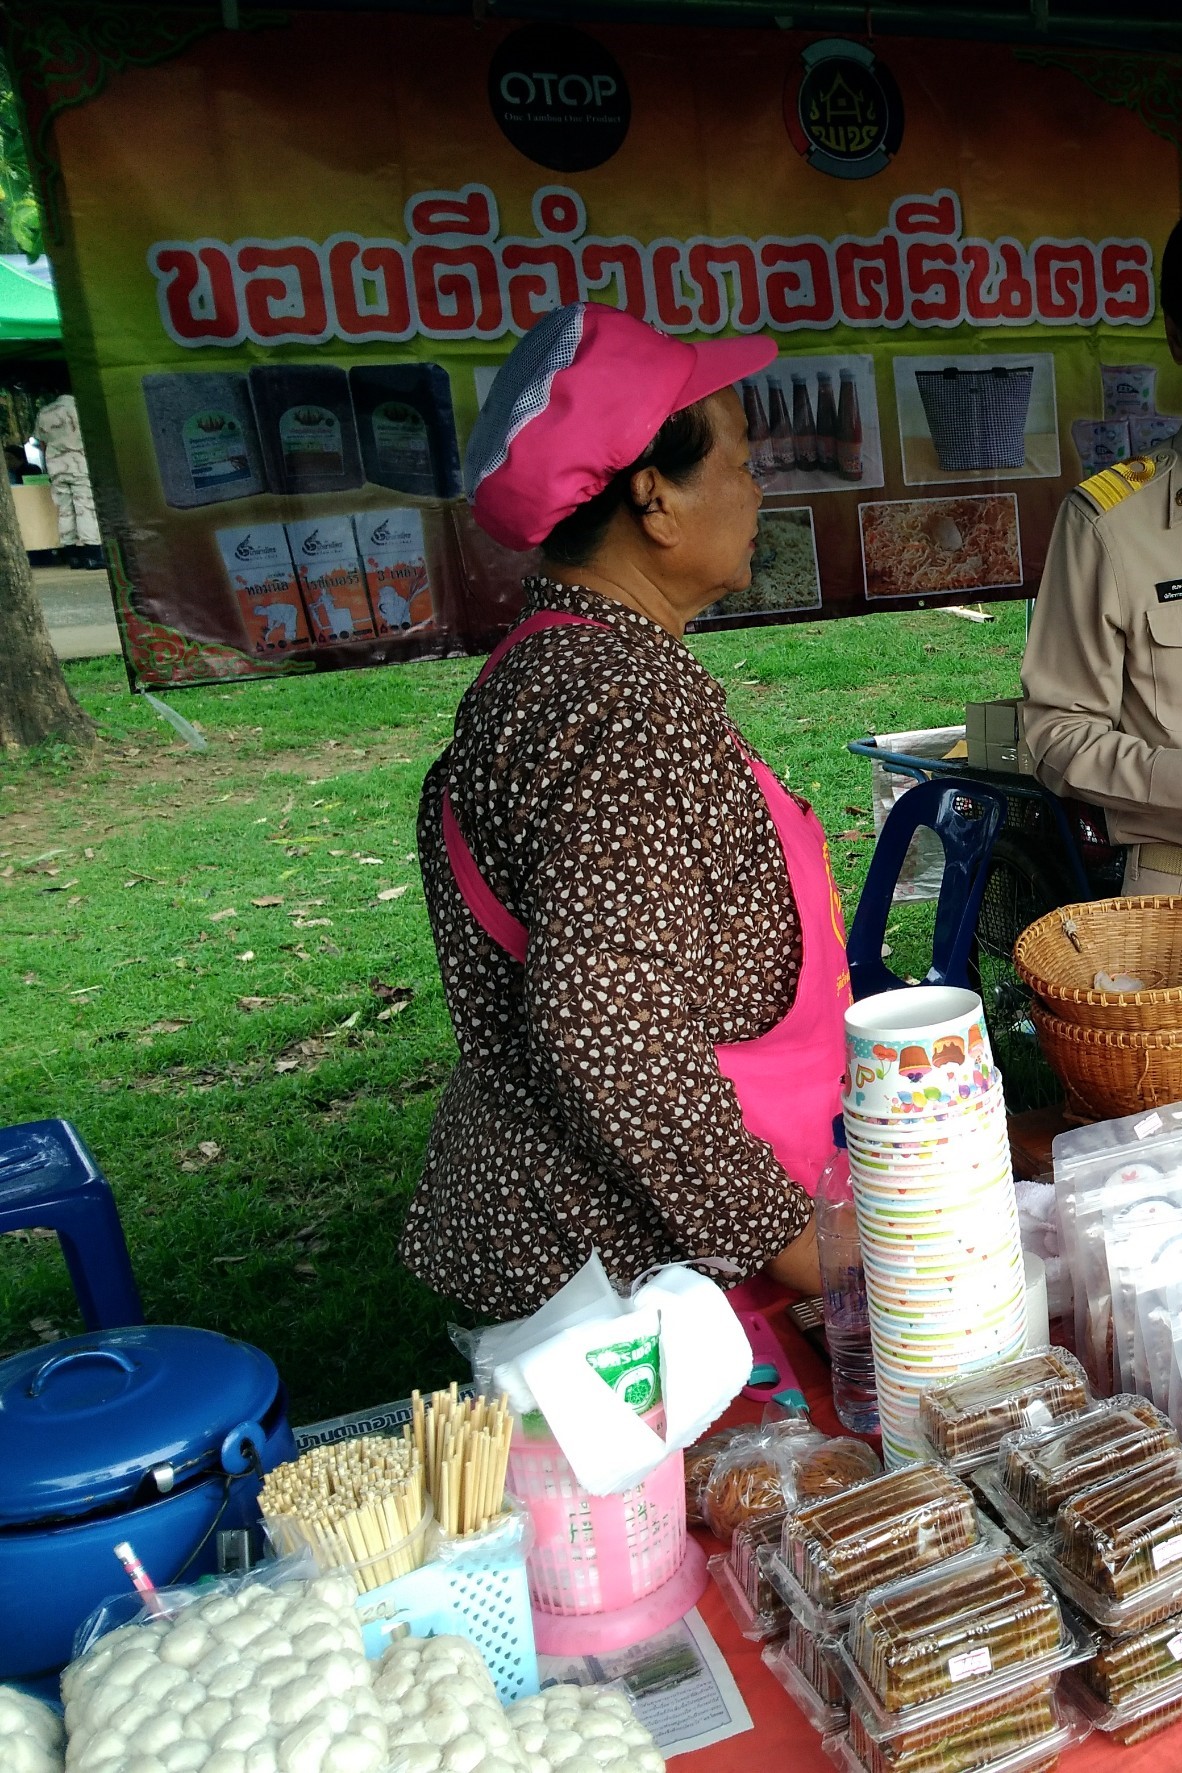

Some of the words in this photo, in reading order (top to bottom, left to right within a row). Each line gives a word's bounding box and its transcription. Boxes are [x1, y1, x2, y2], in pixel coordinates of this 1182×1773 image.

[499, 71, 617, 107] OTOP
[504, 111, 523, 121] One
[564, 114, 583, 123] One
[586, 114, 622, 124] Product
